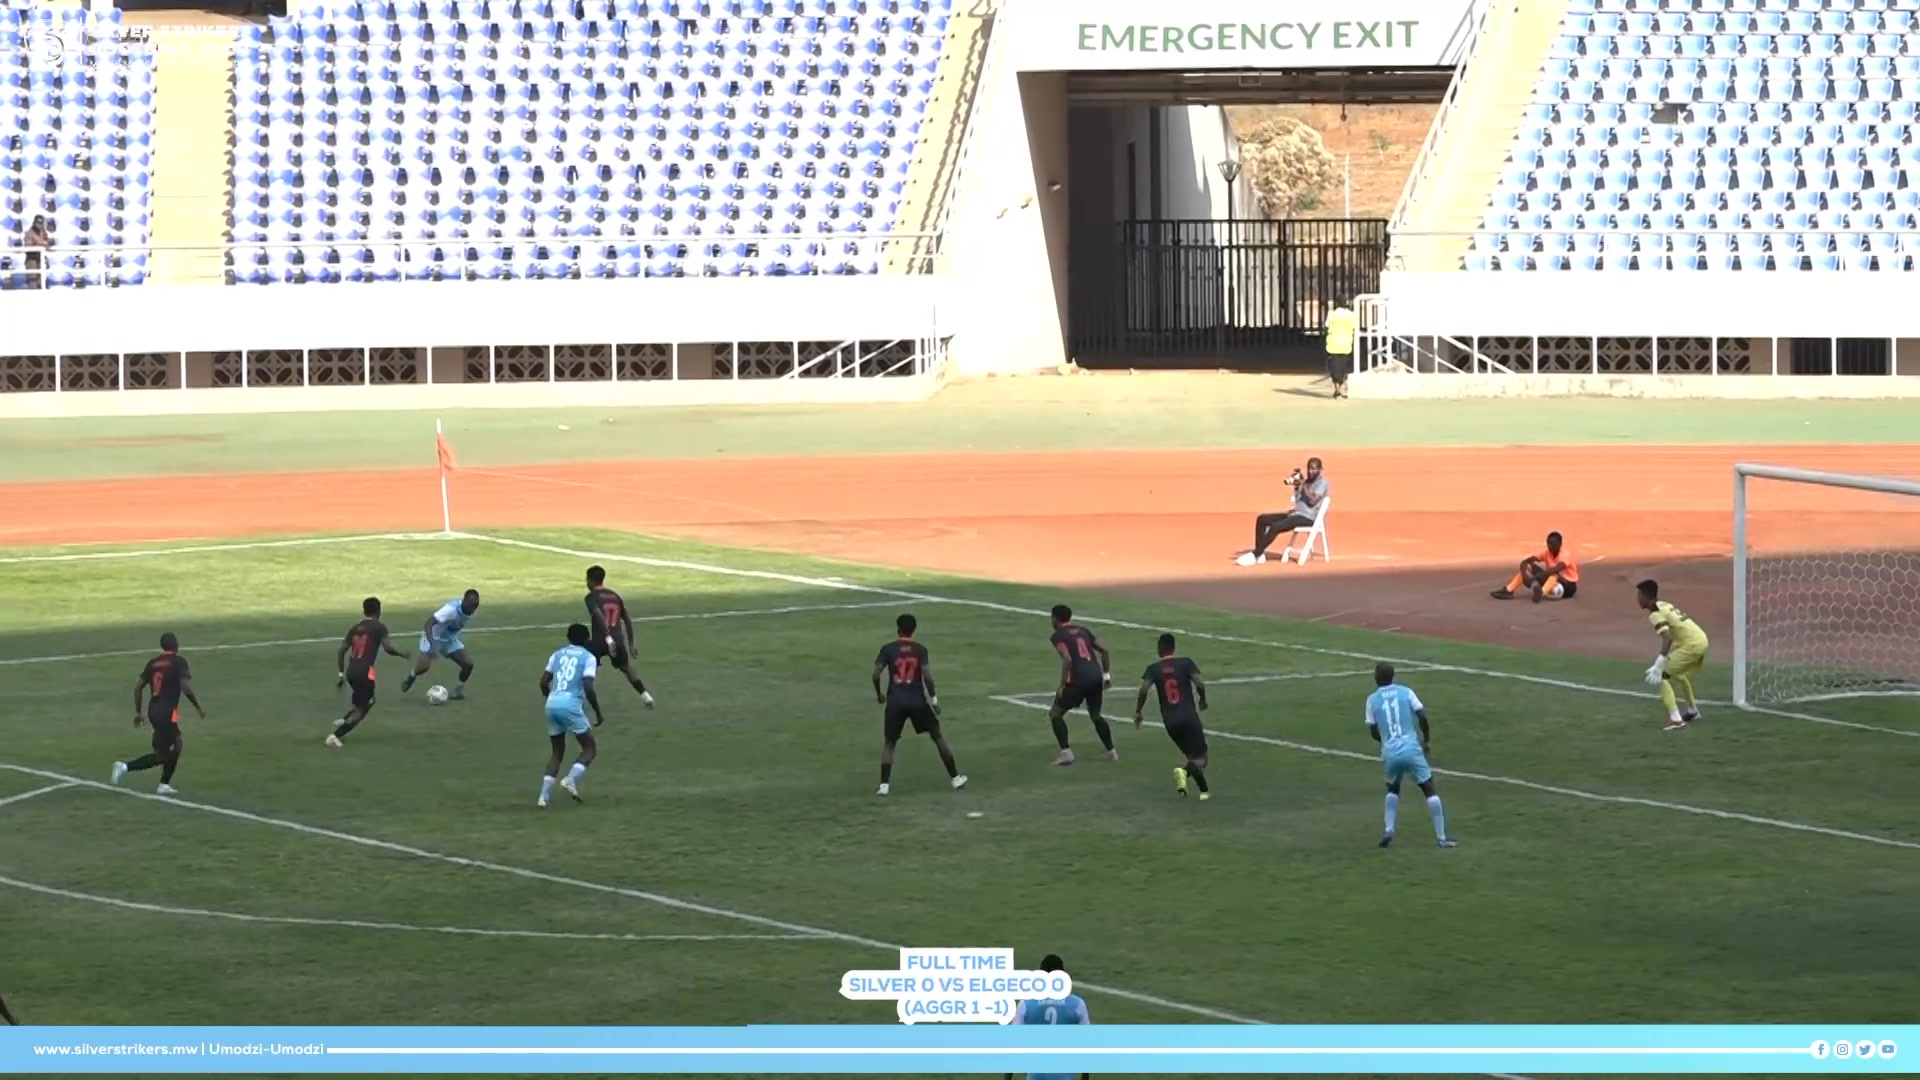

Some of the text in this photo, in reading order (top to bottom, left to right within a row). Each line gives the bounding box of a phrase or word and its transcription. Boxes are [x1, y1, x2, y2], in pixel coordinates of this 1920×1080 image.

[1078, 21, 1419, 52] EMERGENCY EXIT
[557, 655, 578, 681] 36
[1164, 679, 1180, 704] 6
